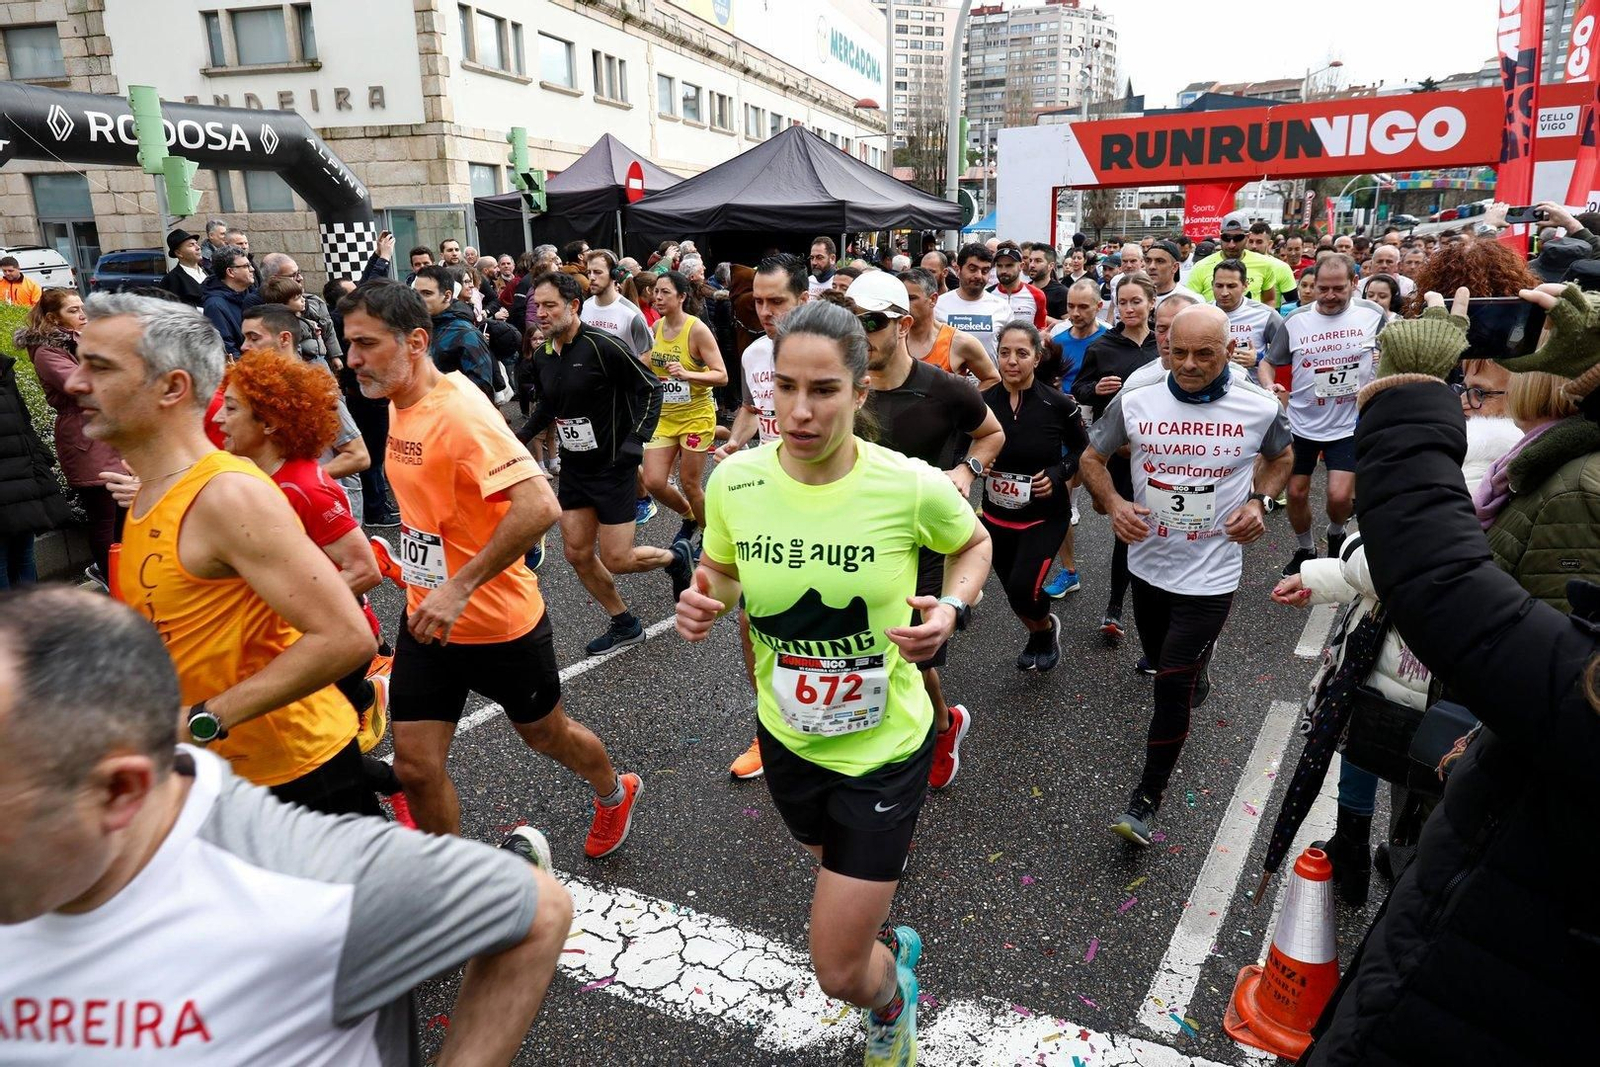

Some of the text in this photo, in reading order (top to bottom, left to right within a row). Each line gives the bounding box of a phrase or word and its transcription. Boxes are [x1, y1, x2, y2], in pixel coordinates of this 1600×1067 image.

[830, 27, 882, 85] MERCADONA
[159, 85, 387, 113] NDEIRA
[1539, 112, 1574, 123] CELLO
[1540, 122, 1566, 131] VIGO
[1099, 105, 1467, 171] RUNRUNVIGO
[305, 137, 365, 200] ALPINE
[1192, 204, 1215, 213] Sports
[1300, 329, 1364, 345] VI CARREIRA
[1300, 343, 1342, 356] CALVARIO
[1313, 354, 1363, 367] Santander
[1328, 371, 1347, 385] 67
[562, 426, 580, 439] 56
[1139, 421, 1244, 437] VI CARREIRA
[1140, 443, 1206, 456] CALVARIO
[1212, 445, 1221, 457] 5
[1233, 446, 1241, 457] 5
[1158, 462, 1238, 478] Santander
[727, 480, 755, 492] luanvi
[992, 479, 1020, 497] 624
[1170, 494, 1185, 512] 3
[403, 538, 429, 566] 107
[735, 535, 875, 573] máis que auga
[795, 674, 864, 707] 672
[0, 997, 213, 1049] RREIRA
